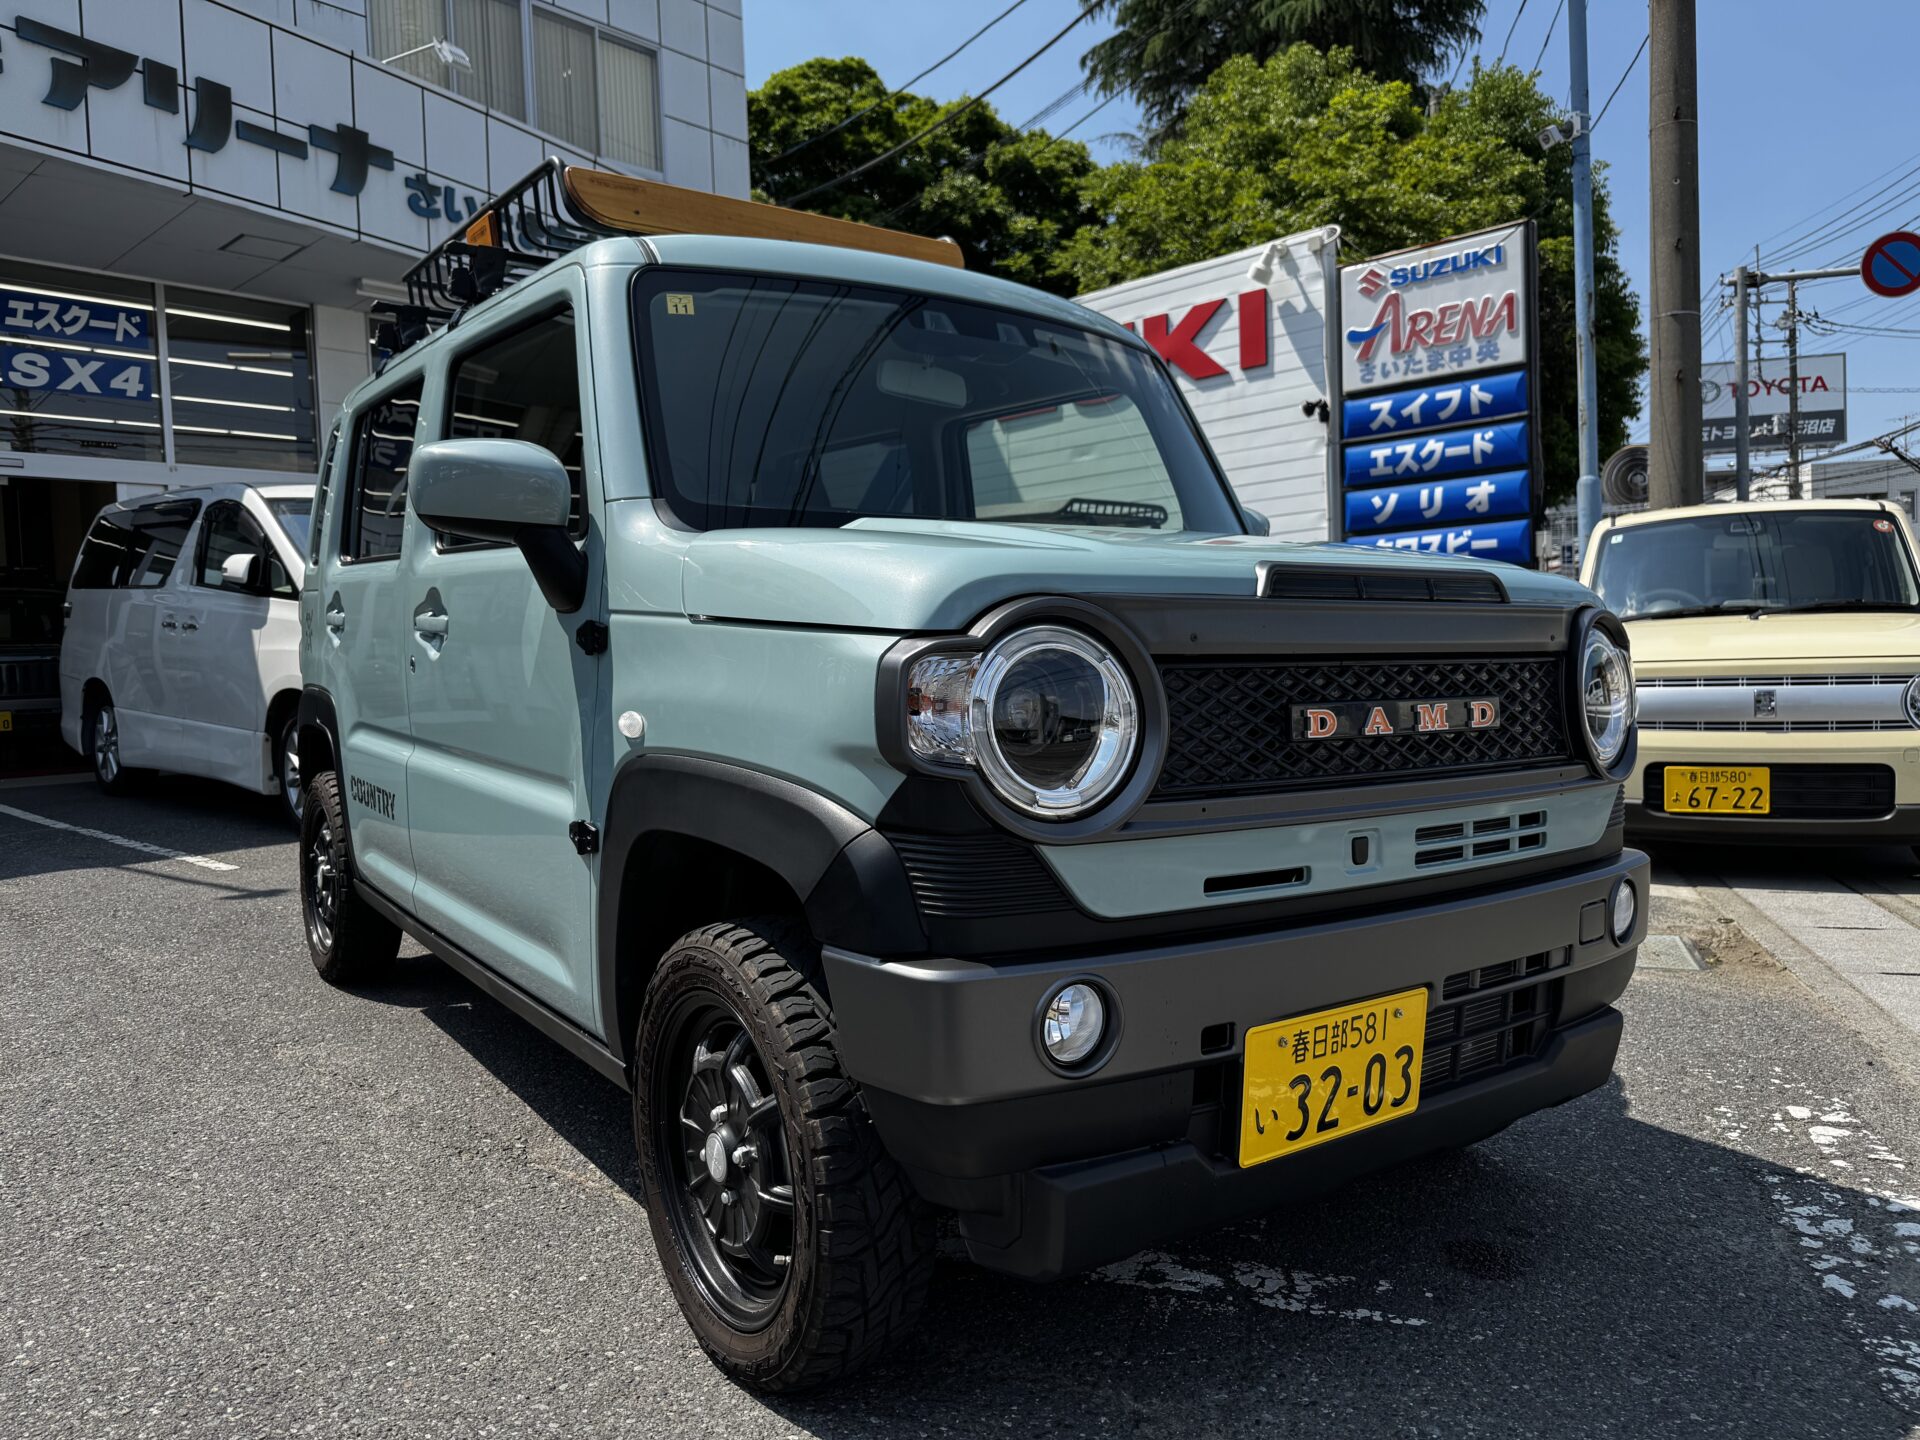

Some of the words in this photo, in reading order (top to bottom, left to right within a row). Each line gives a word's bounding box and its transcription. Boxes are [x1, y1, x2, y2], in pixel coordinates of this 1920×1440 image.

[0, 15, 394, 196] アリーナ
[404, 173, 482, 224] さい
[1390, 243, 1504, 287] SUZUKI
[5, 299, 142, 342] エスクード
[672, 304, 688, 314] 11
[1351, 290, 1516, 363] ARENA
[1123, 288, 1267, 380] KI
[8, 352, 144, 398] SX4
[1359, 339, 1500, 384] さいたま中央
[1369, 384, 1494, 431] スイフト
[1369, 430, 1494, 477] エスクード
[1371, 480, 1495, 525] ソリオ
[1307, 701, 1496, 739] DAMD
[350, 775, 396, 821] COUNTRY
[1688, 786, 1764, 809] 67-22
[1255, 1108, 1279, 1135] い
[1285, 1044, 1415, 1142] 32-03
